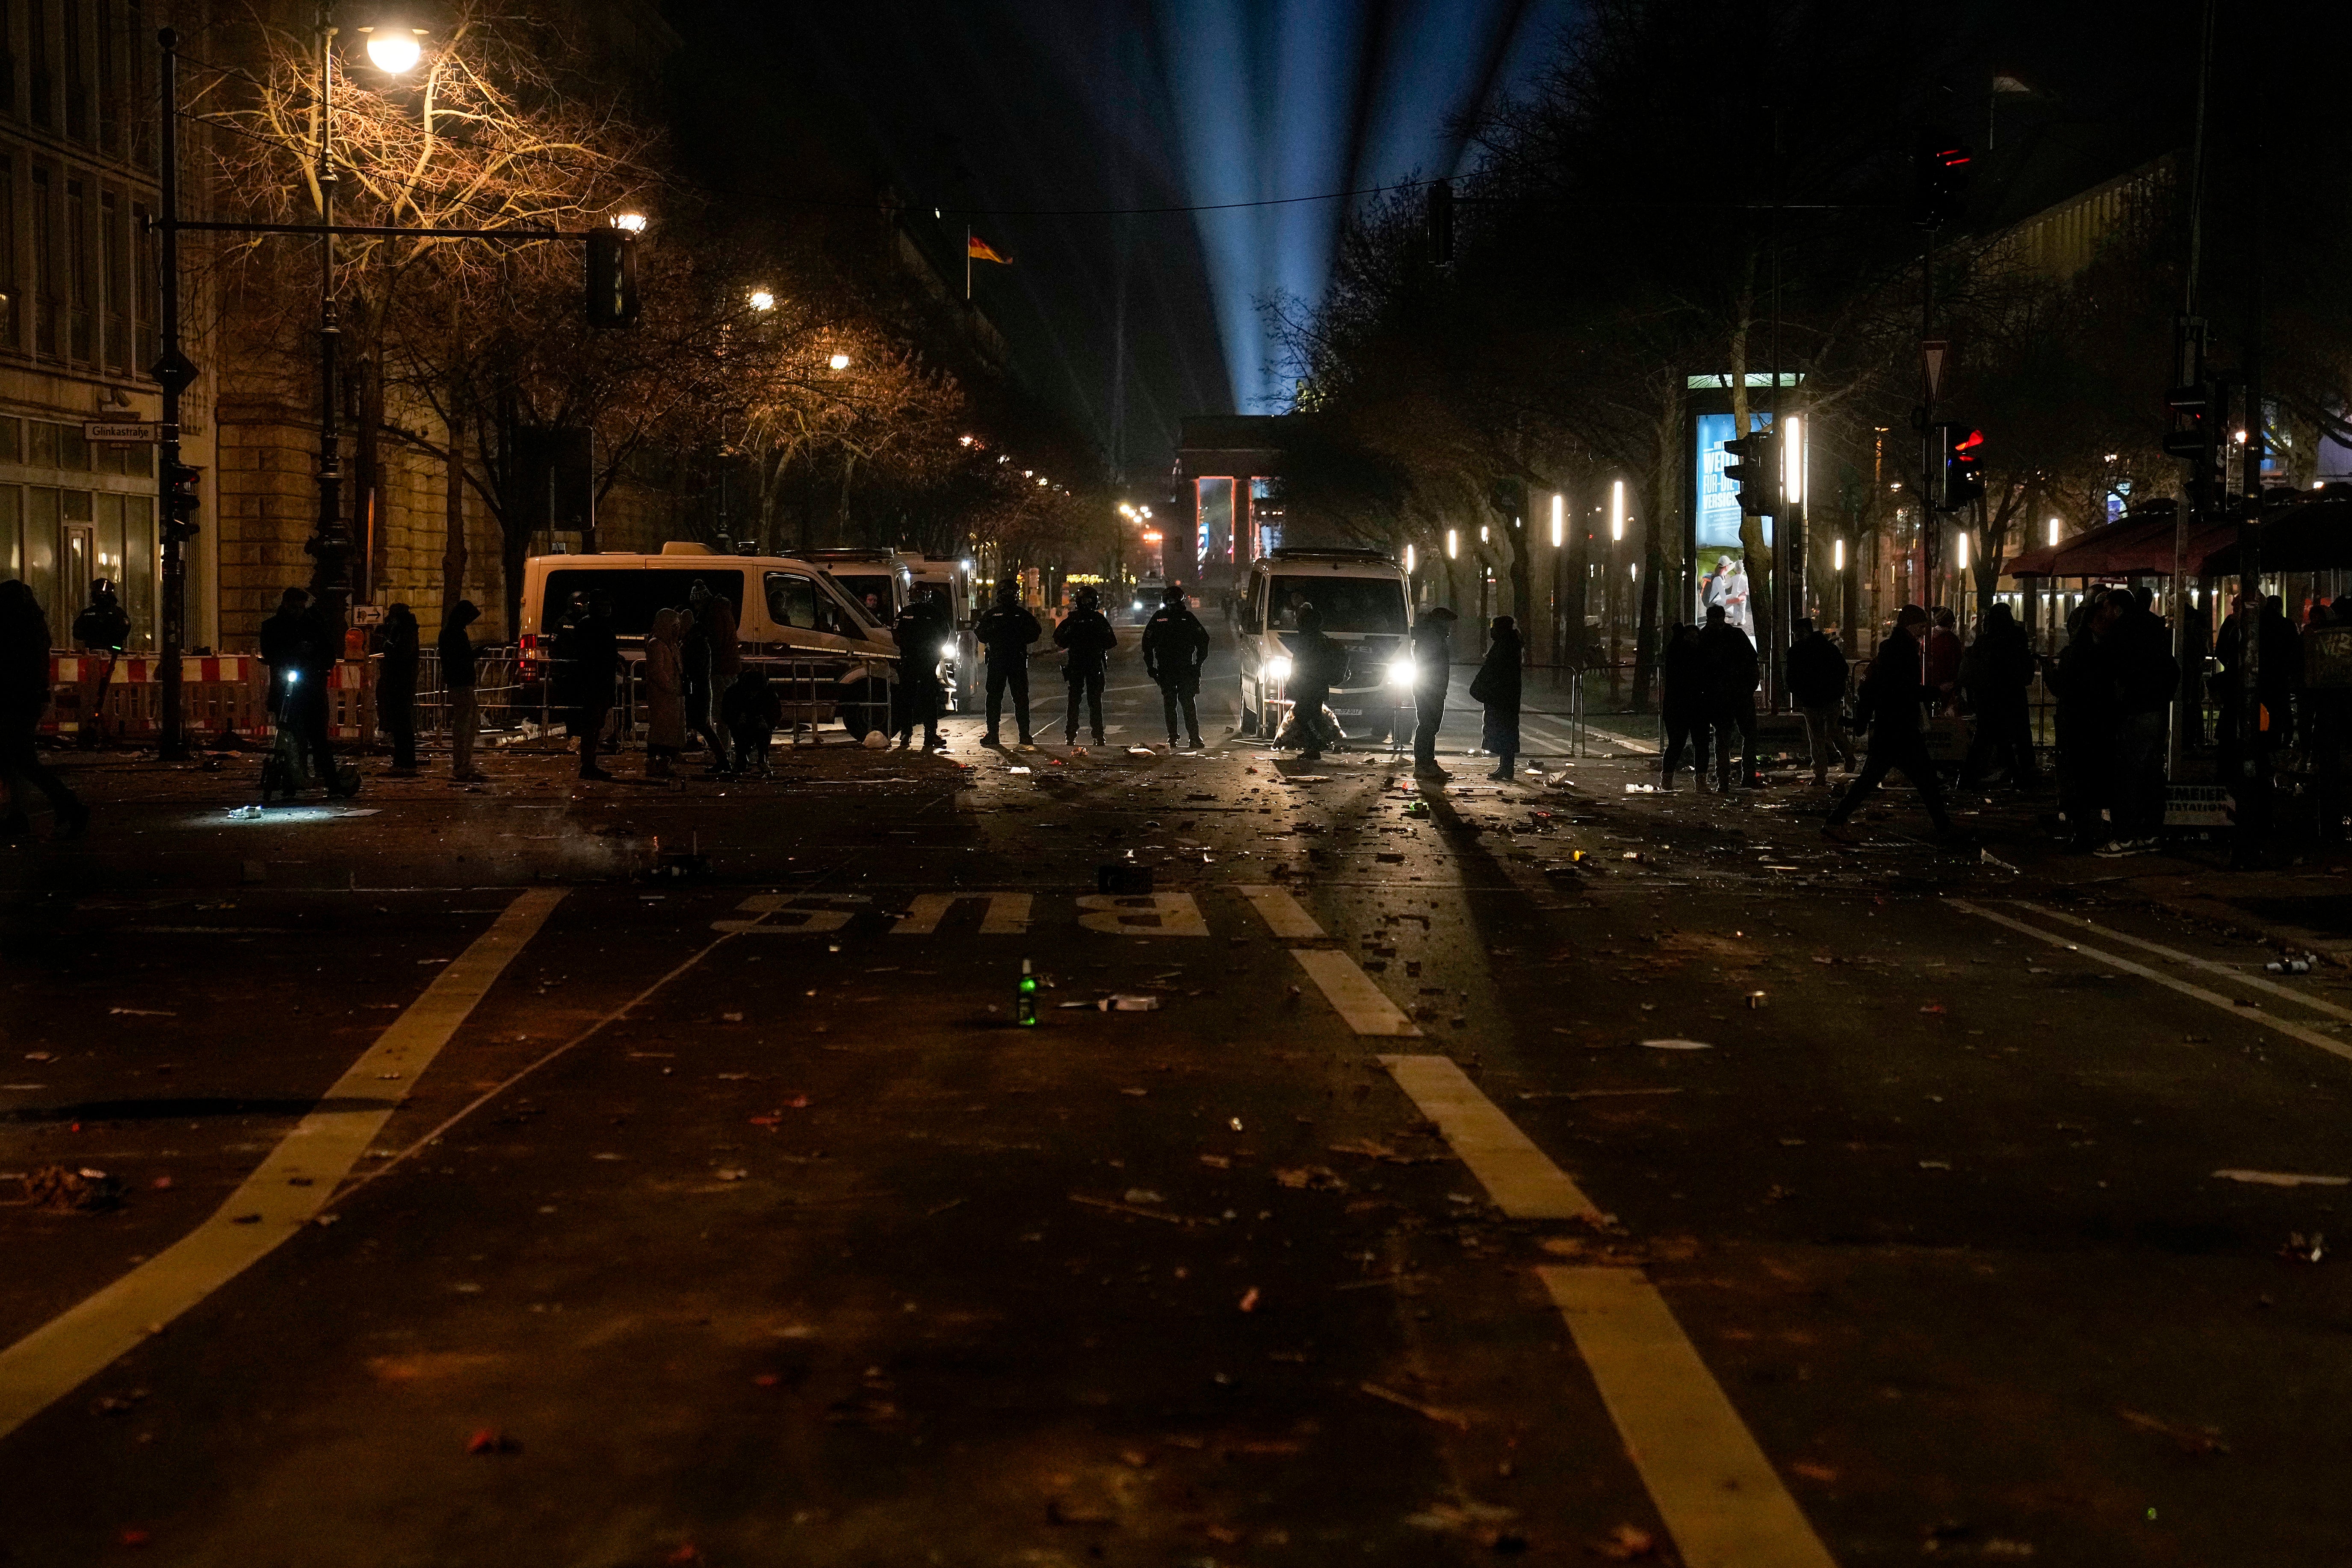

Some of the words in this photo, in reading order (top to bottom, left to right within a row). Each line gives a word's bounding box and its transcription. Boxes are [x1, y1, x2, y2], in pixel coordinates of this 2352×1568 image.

[92, 426, 148, 438] Glinkastraße
[1703, 490, 1740, 509] VERSICH
[709, 892, 1210, 936] BUS
